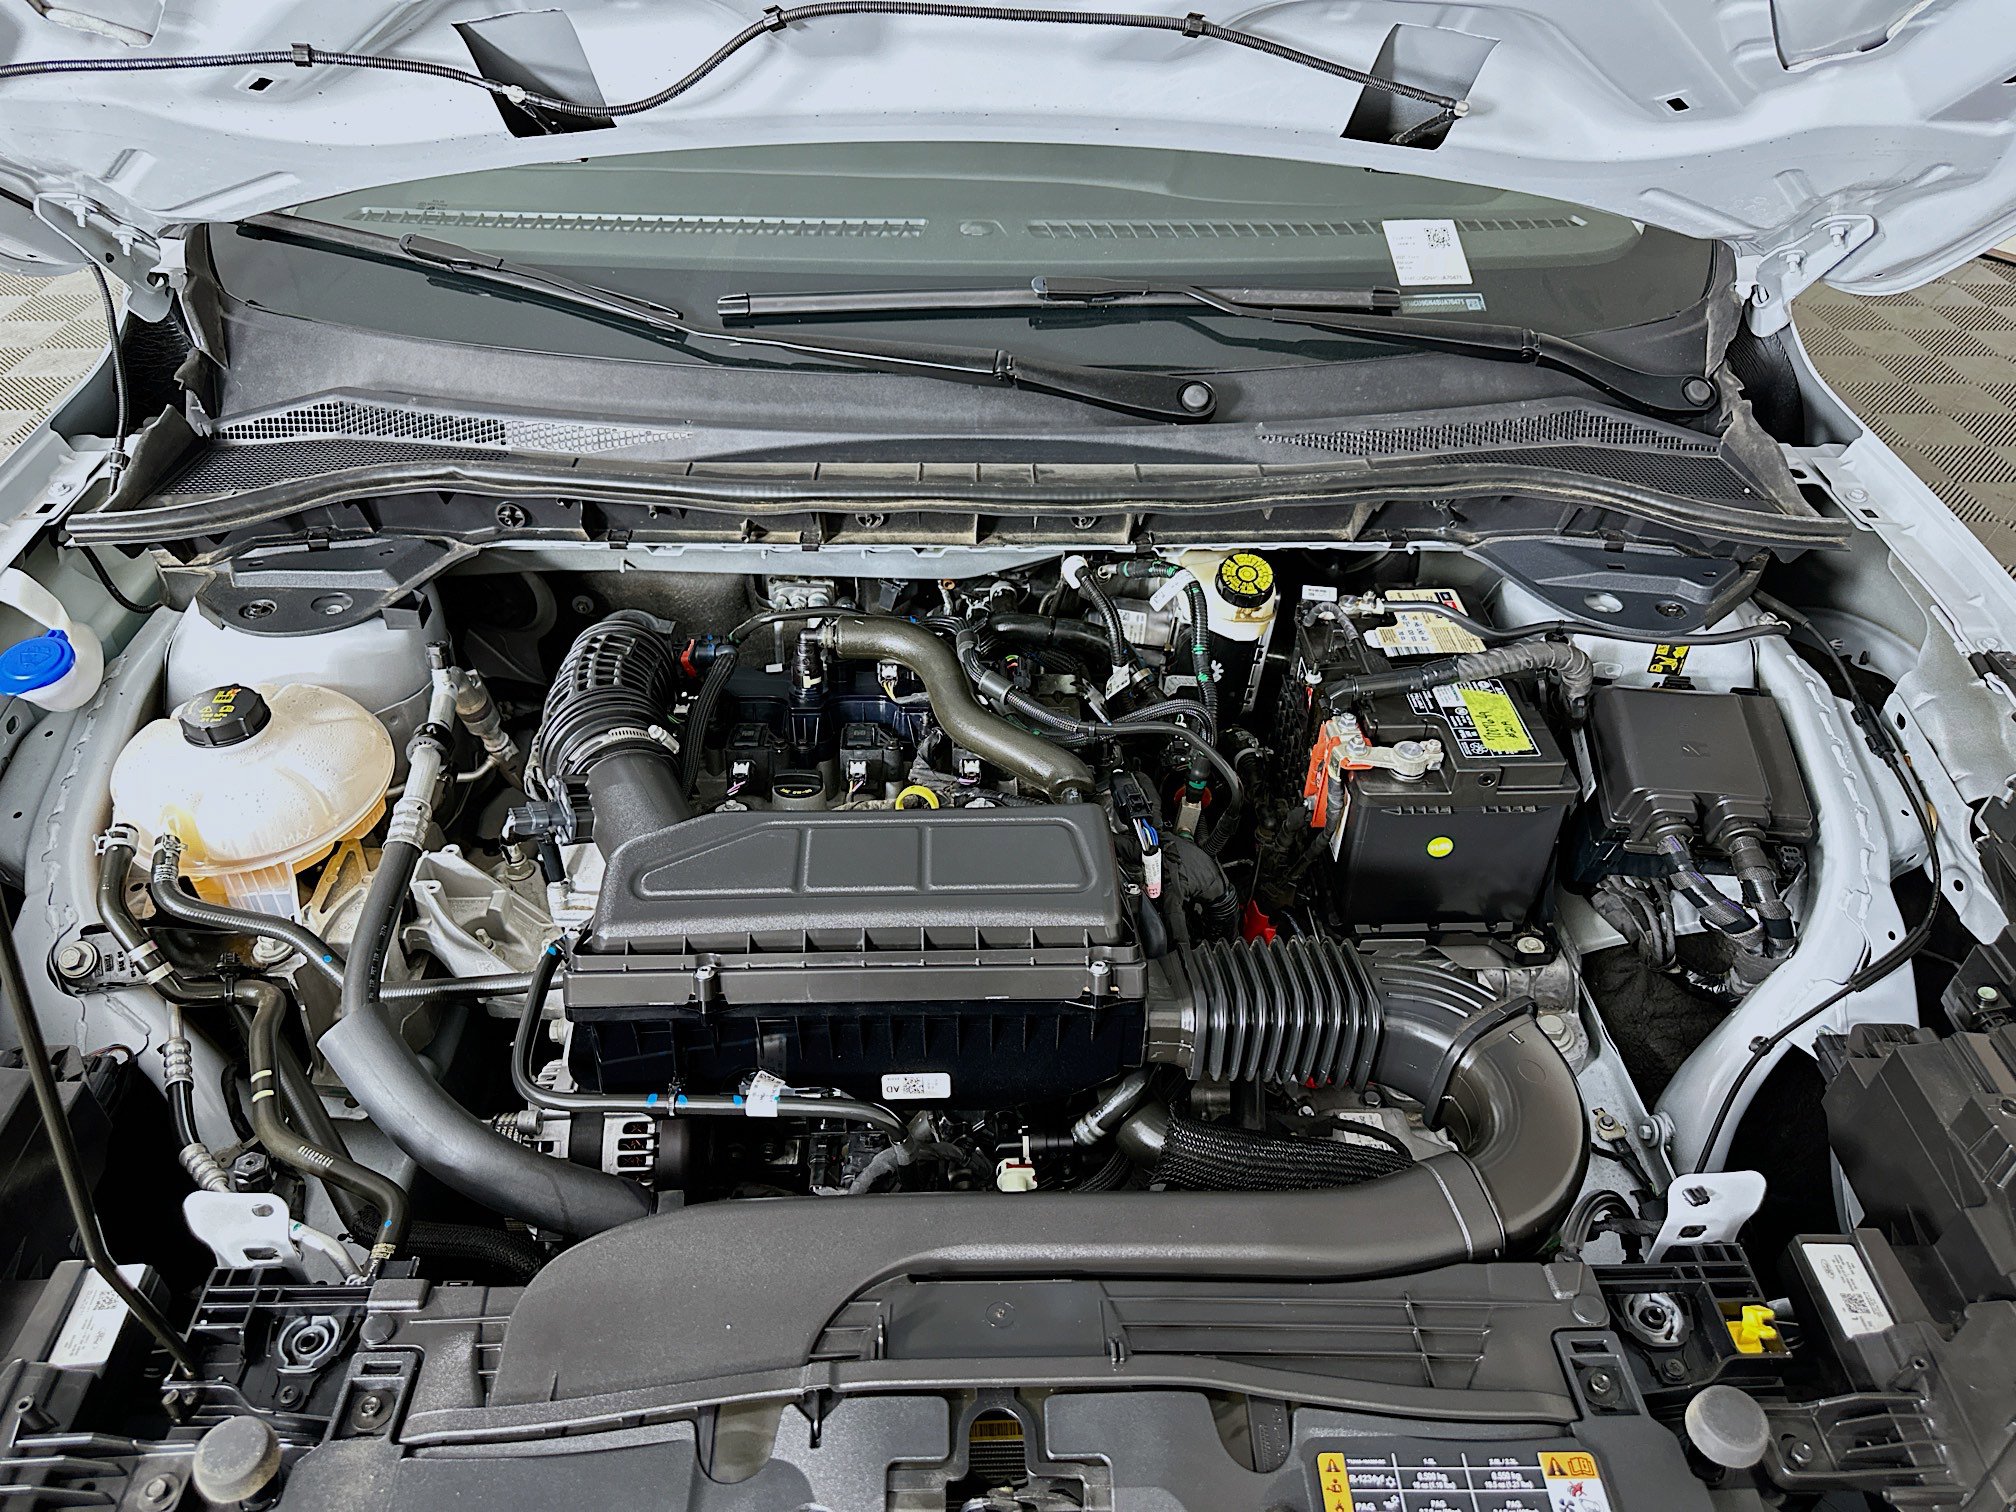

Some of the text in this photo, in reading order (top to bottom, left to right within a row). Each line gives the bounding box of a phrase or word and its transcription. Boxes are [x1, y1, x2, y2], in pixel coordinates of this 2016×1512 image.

[886, 1085, 900, 1093] AD
[1436, 1471, 1449, 1483] kg
[1510, 1471, 1523, 1482] kg
